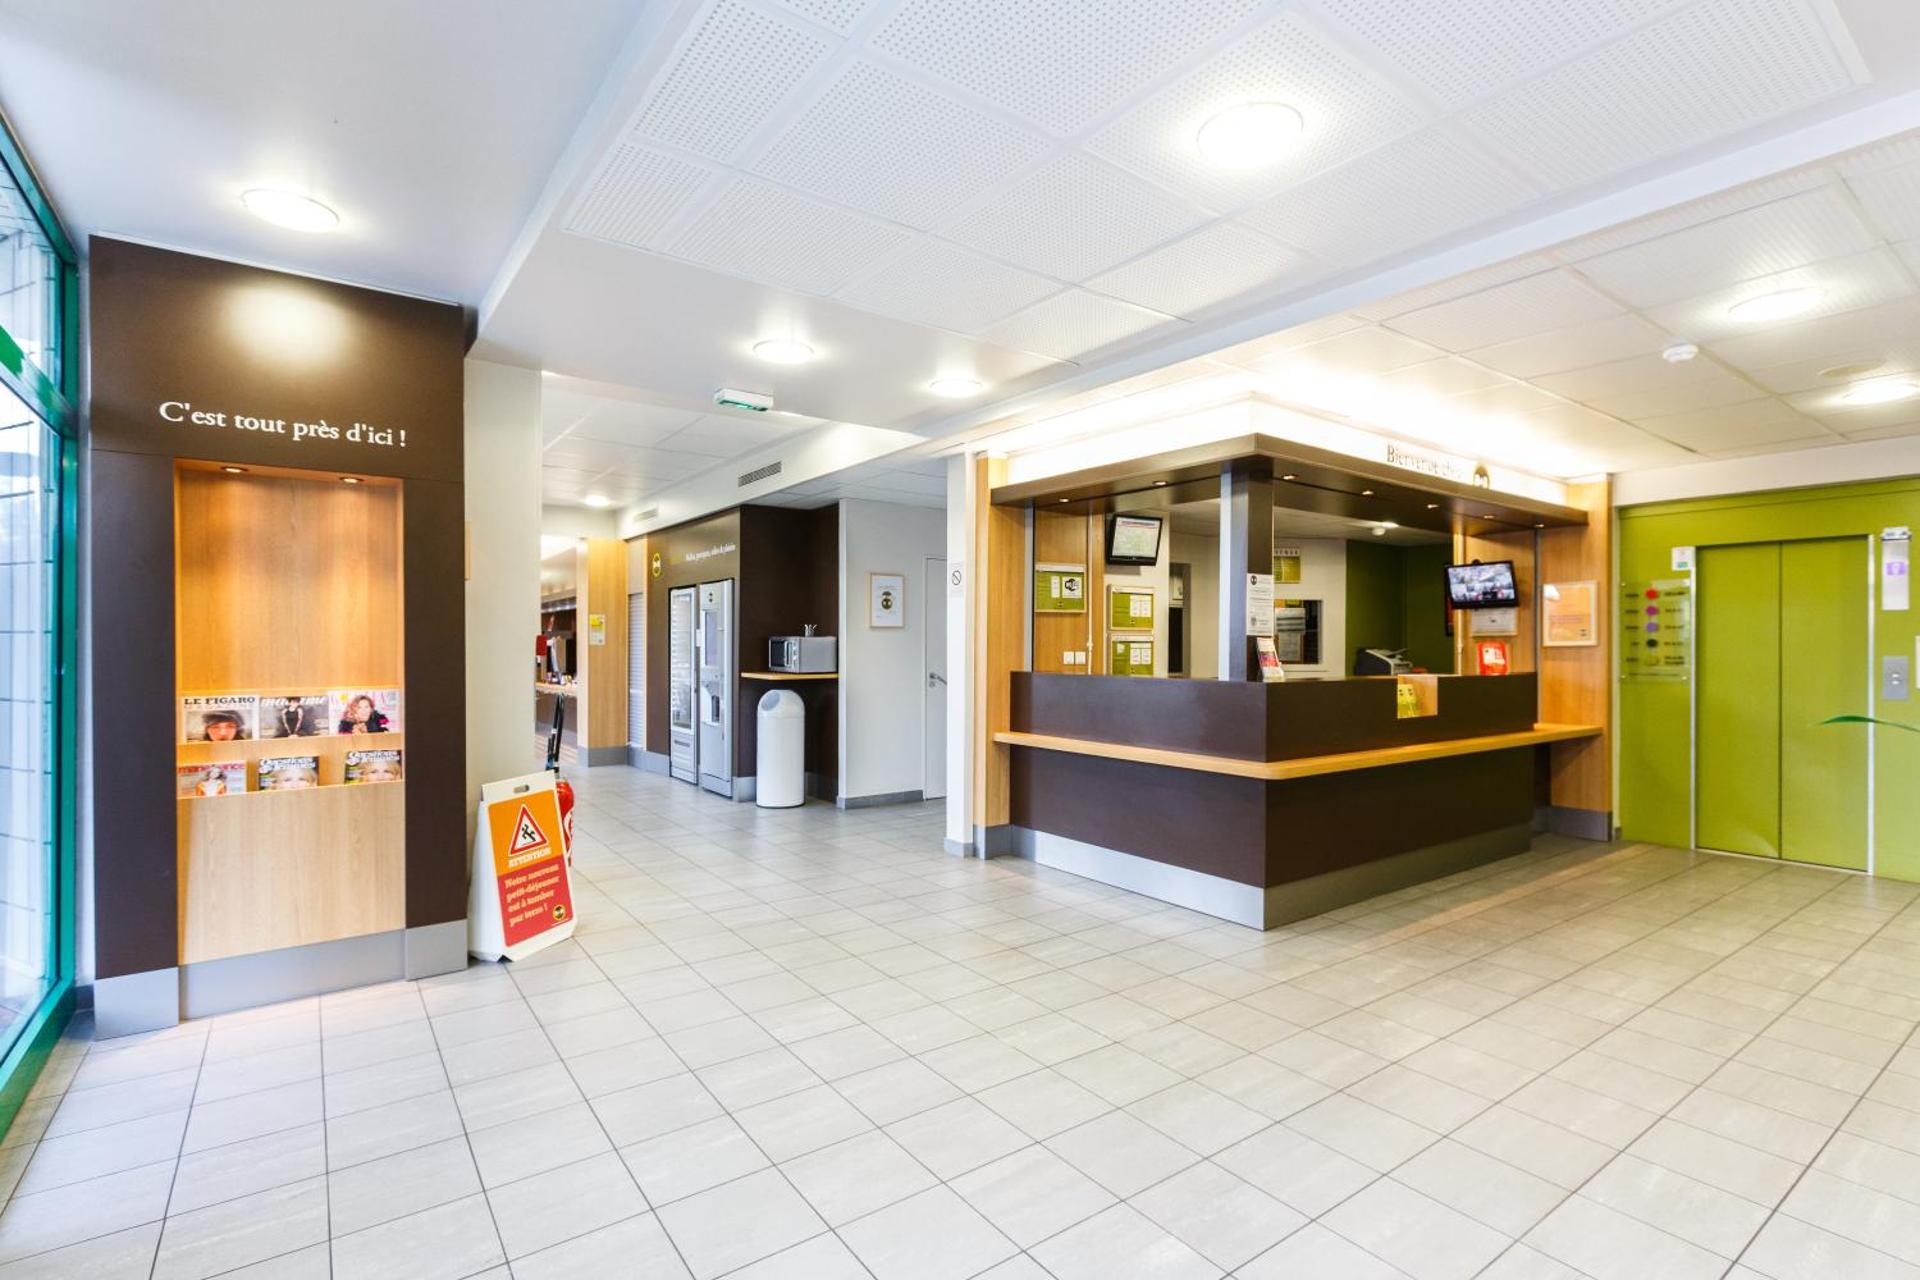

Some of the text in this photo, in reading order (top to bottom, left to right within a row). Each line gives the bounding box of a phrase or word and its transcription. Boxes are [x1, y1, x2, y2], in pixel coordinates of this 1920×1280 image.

[159, 401, 407, 447] C'est tout près d'ici !
[206, 697, 255, 705] FIGARO
[504, 875, 527, 889] Notre
